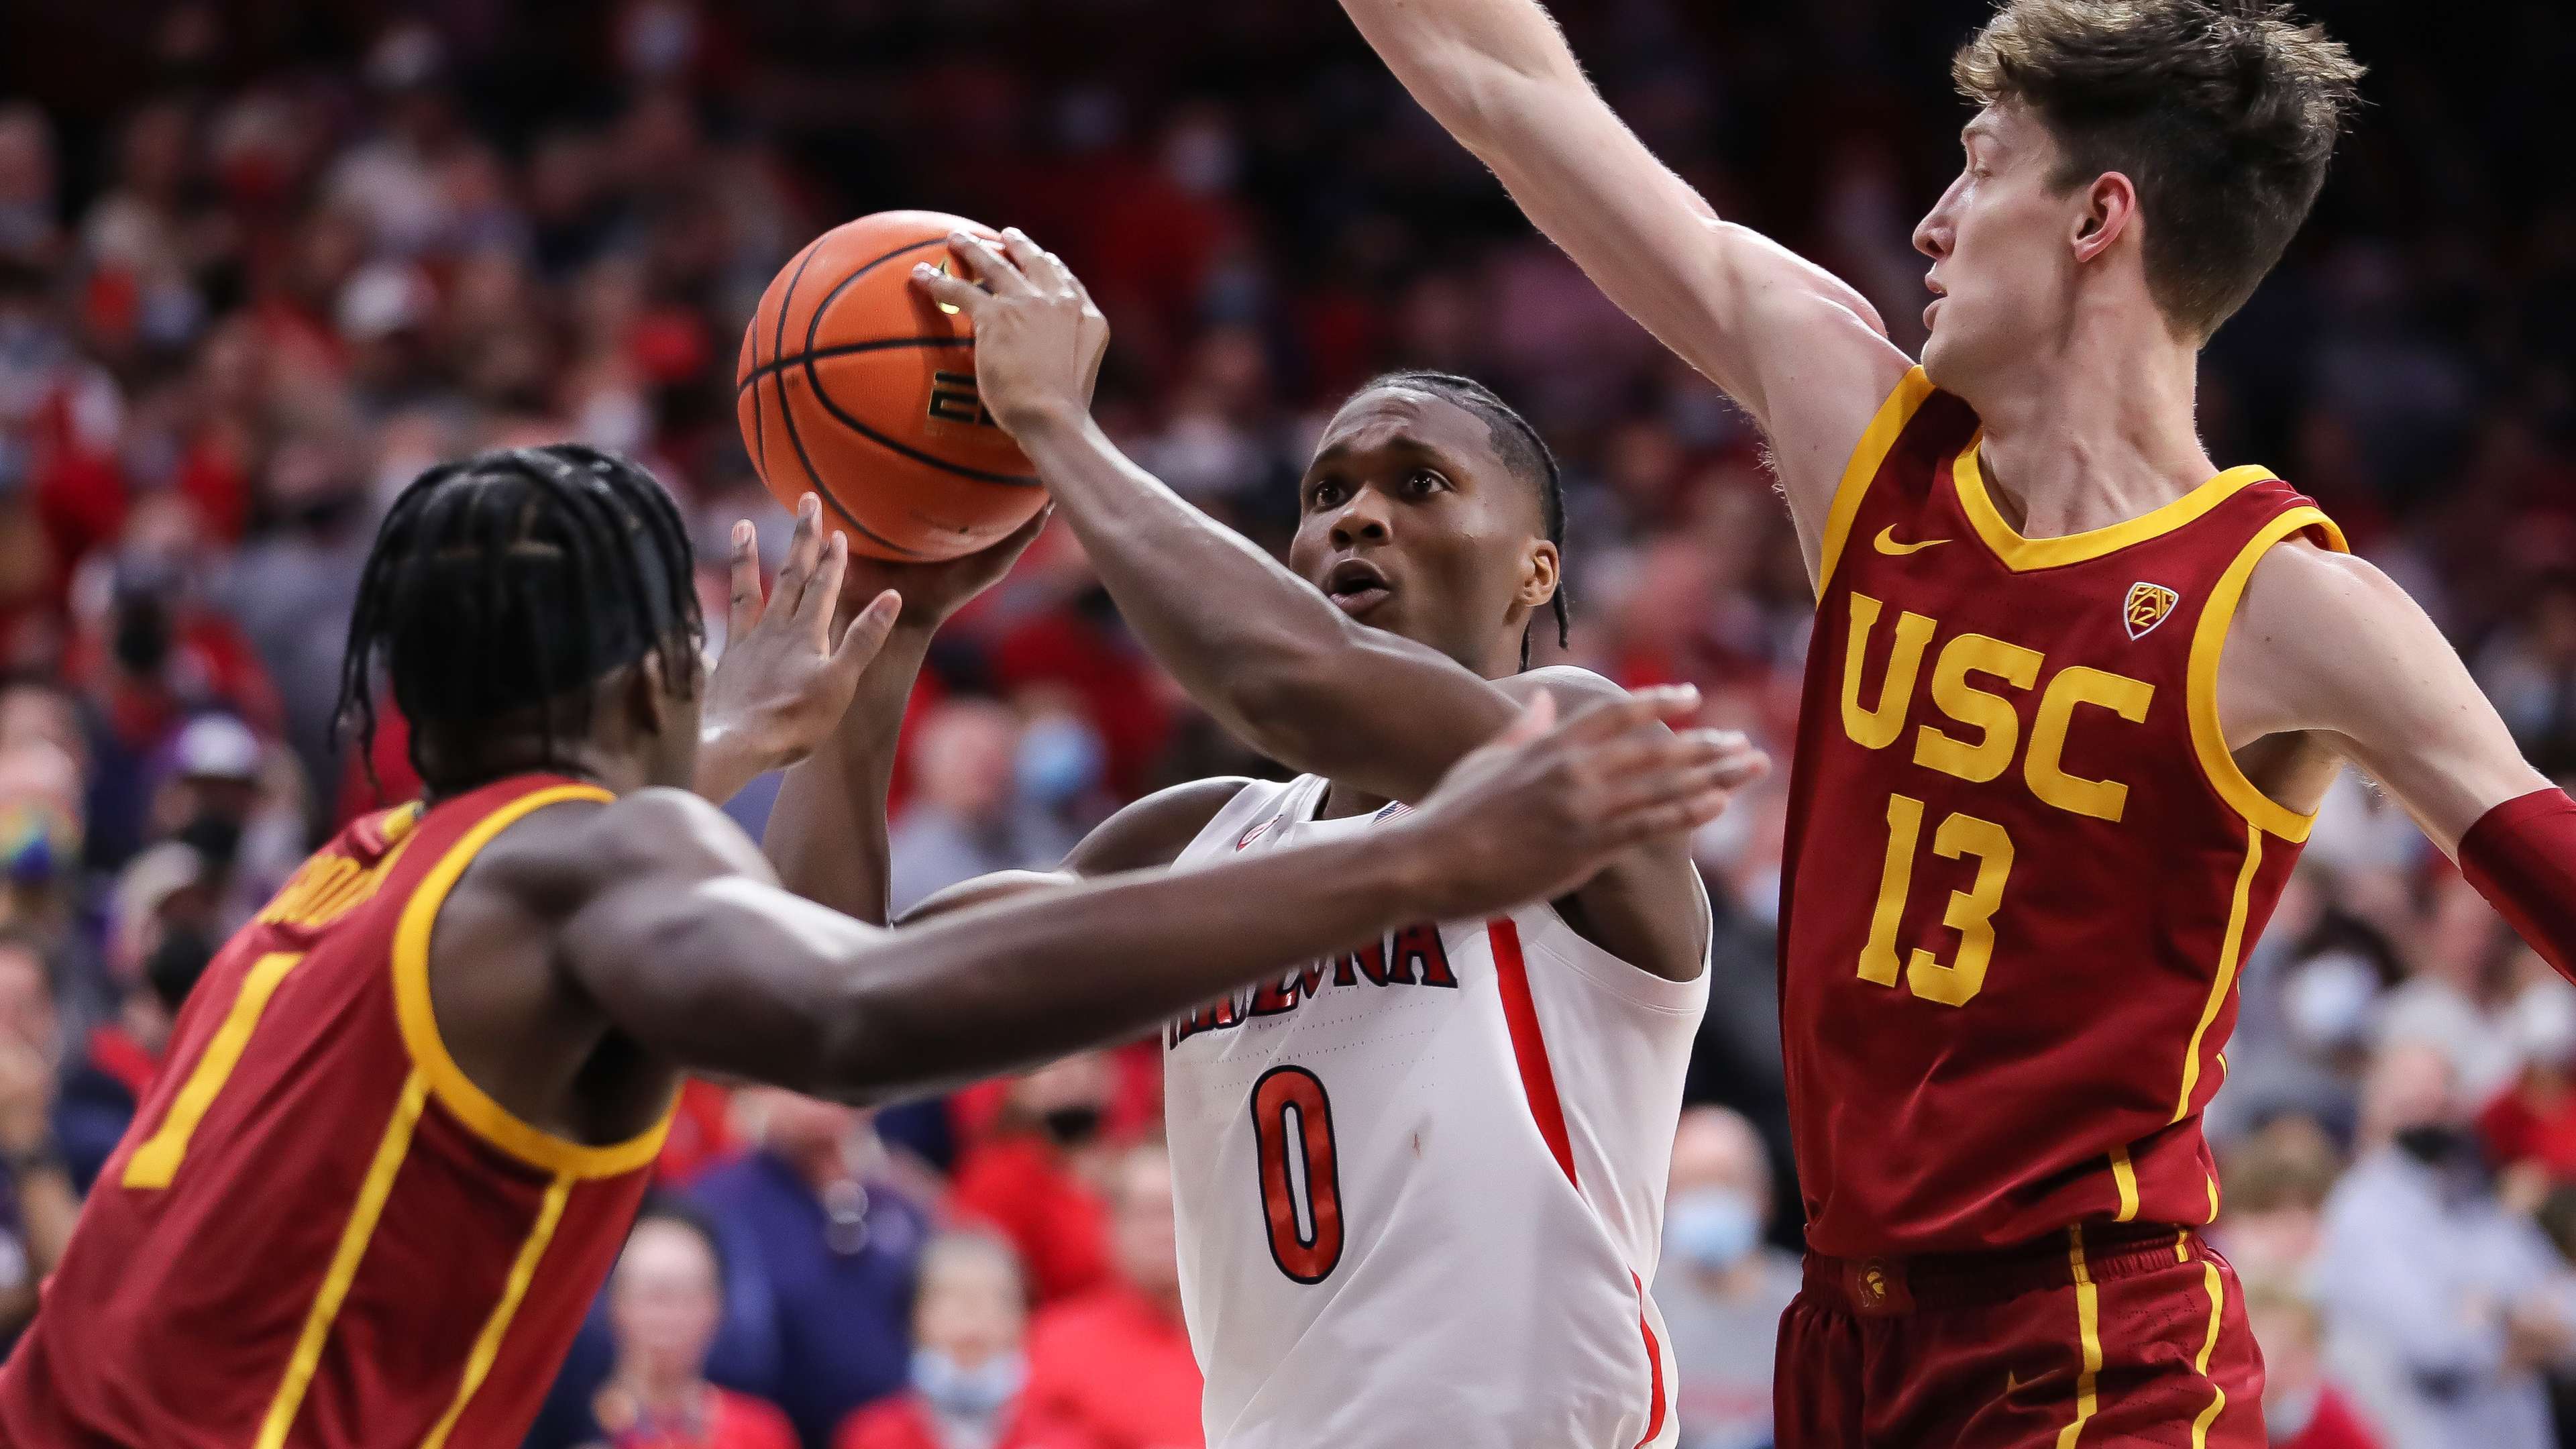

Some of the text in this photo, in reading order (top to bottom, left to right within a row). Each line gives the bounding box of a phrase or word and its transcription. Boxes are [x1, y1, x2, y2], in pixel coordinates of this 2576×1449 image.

[1841, 591, 2155, 822] USC
[2129, 584, 2175, 620] PAC
[2129, 605, 2157, 627] 12
[1856, 793, 2015, 1008] 13
[121, 951, 305, 1189] 1
[1250, 1064, 1345, 1285] 0
